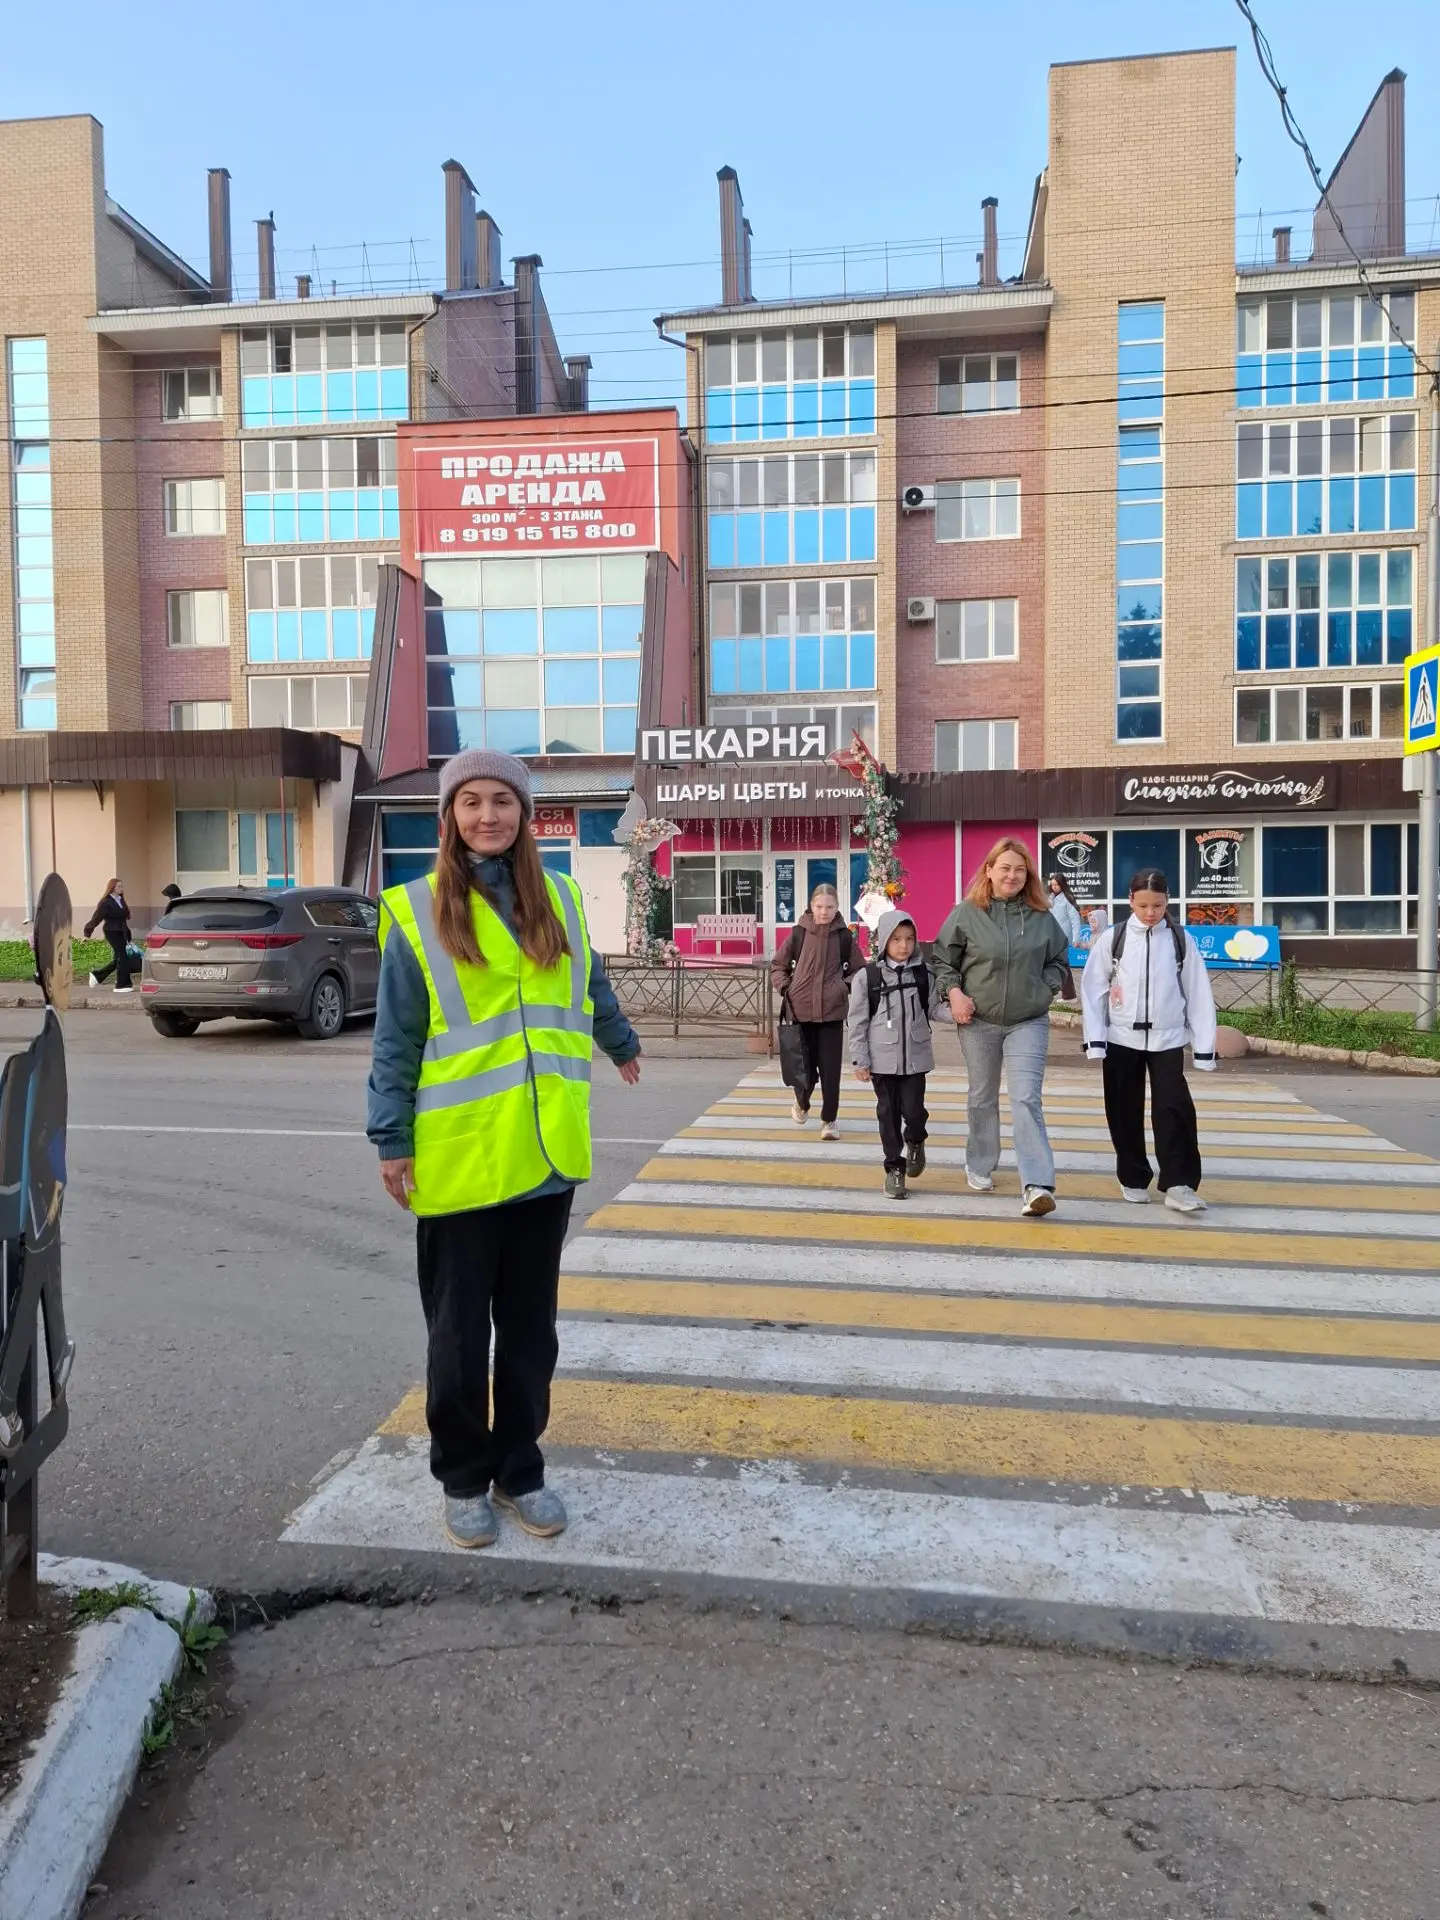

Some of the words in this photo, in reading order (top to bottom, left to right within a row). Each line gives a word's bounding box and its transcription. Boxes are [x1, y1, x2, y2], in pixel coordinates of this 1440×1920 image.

[441, 451, 626, 479] ПРОДАЖА
[460, 480, 606, 507] АРЕНДА
[471, 513, 500, 524] 300
[540, 511, 550, 522] 3
[553, 510, 603, 521] ЭТАЖА
[439, 529, 456, 543] 8
[462, 528, 508, 542] 919
[514, 526, 543, 541] 15
[549, 525, 578, 540] 15
[585, 523, 636, 538] 800
[641, 725, 826, 761] ПЕКАРНЯ
[1142, 774, 1210, 784] КАФЕ-ПЕКАРНЯ
[657, 784, 725, 802] ШАРЫ
[733, 782, 807, 803] ЦВЕТЫ
[815, 789, 824, 798] И
[825, 787, 864, 798] ТОЧКА
[1124, 778, 1218, 803] Сладкая
[529, 824, 539, 834] 5
[544, 824, 573, 834] 800
[1210, 874, 1222, 882] 40
